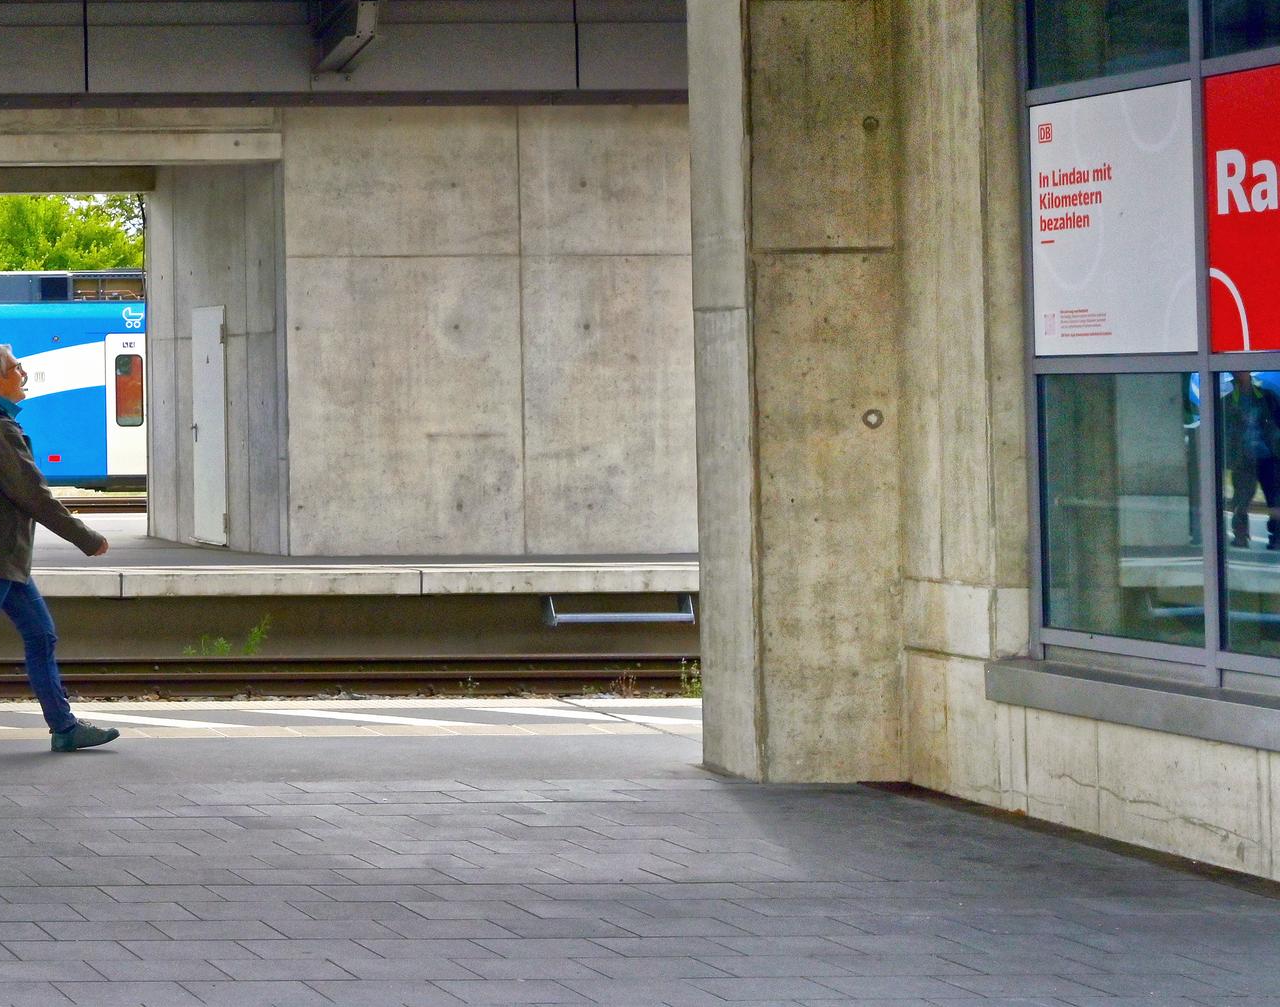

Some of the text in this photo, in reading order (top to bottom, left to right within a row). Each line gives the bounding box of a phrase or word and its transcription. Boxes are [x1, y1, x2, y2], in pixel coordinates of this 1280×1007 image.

[1040, 126, 1051, 141] DB
[1039, 162, 1112, 188] In Lindau mit
[1039, 190, 1103, 210] Kilometern
[1040, 212, 1090, 232] bezahlen
